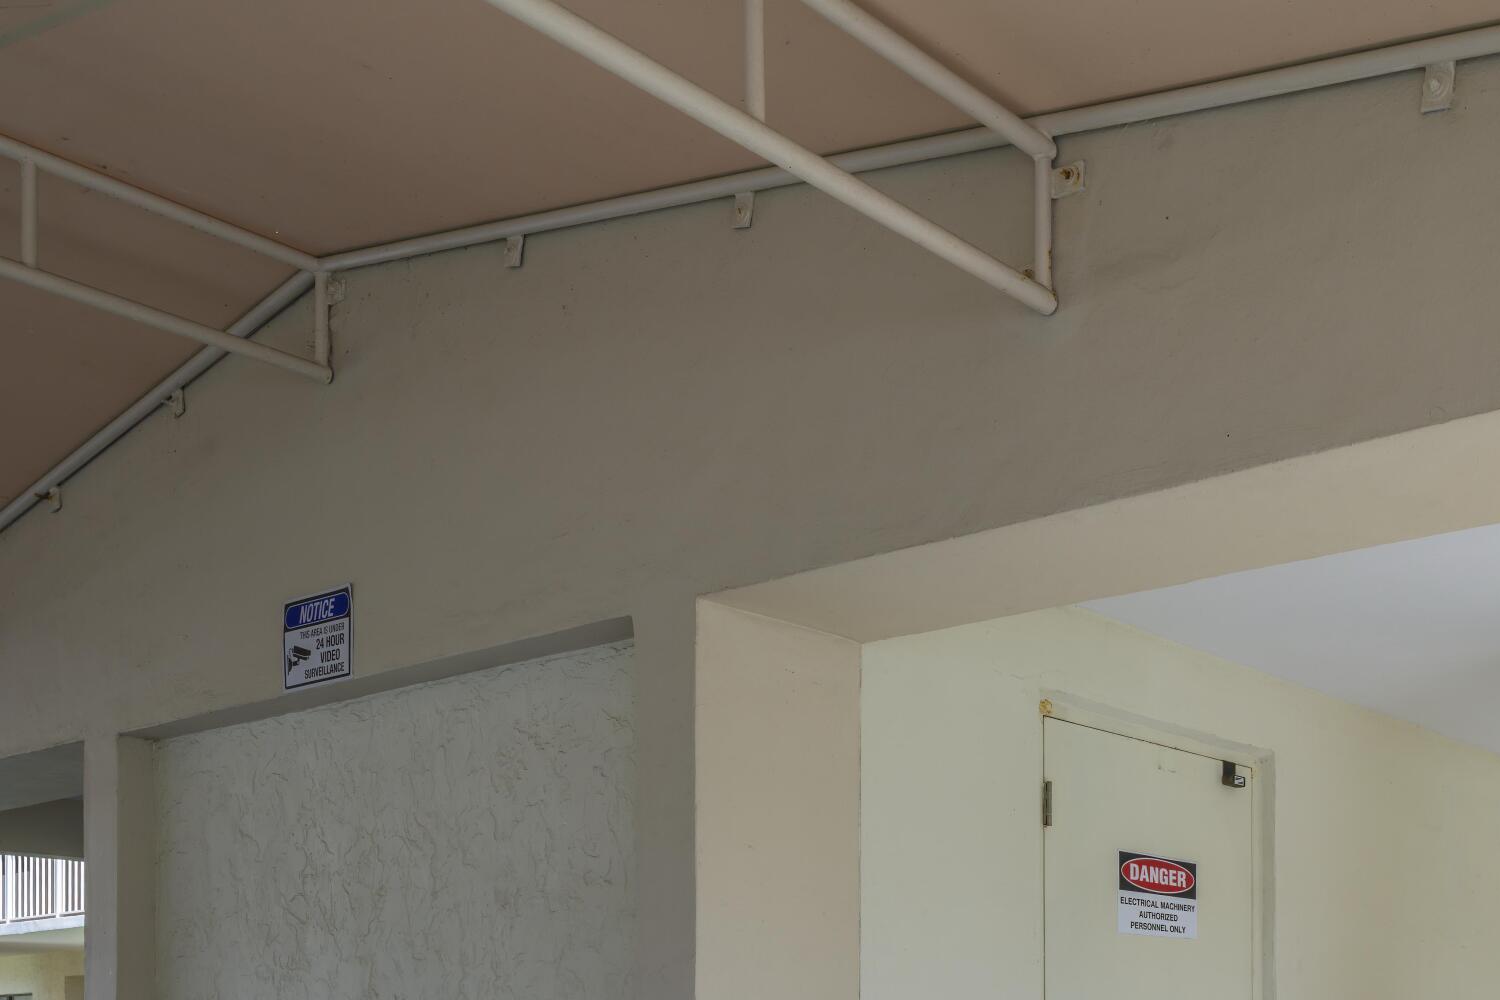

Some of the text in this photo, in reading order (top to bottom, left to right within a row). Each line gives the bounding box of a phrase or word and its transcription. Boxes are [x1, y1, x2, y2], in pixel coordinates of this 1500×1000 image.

[299, 597, 336, 624] NOTICE
[300, 622, 345, 639] THIS AREA IS UNDER
[316, 633, 345, 650] 24 HOUR
[320, 649, 341, 663] VIDEO
[304, 662, 345, 680] SURVEILLANCE
[1129, 862, 1187, 888] DANGER
[1120, 896, 1195, 912] ELECTRICAL MACHINERY
[1139, 910, 1179, 922] AUTHORIZED
[1130, 921, 1186, 934] PERSONNEL ONLY
